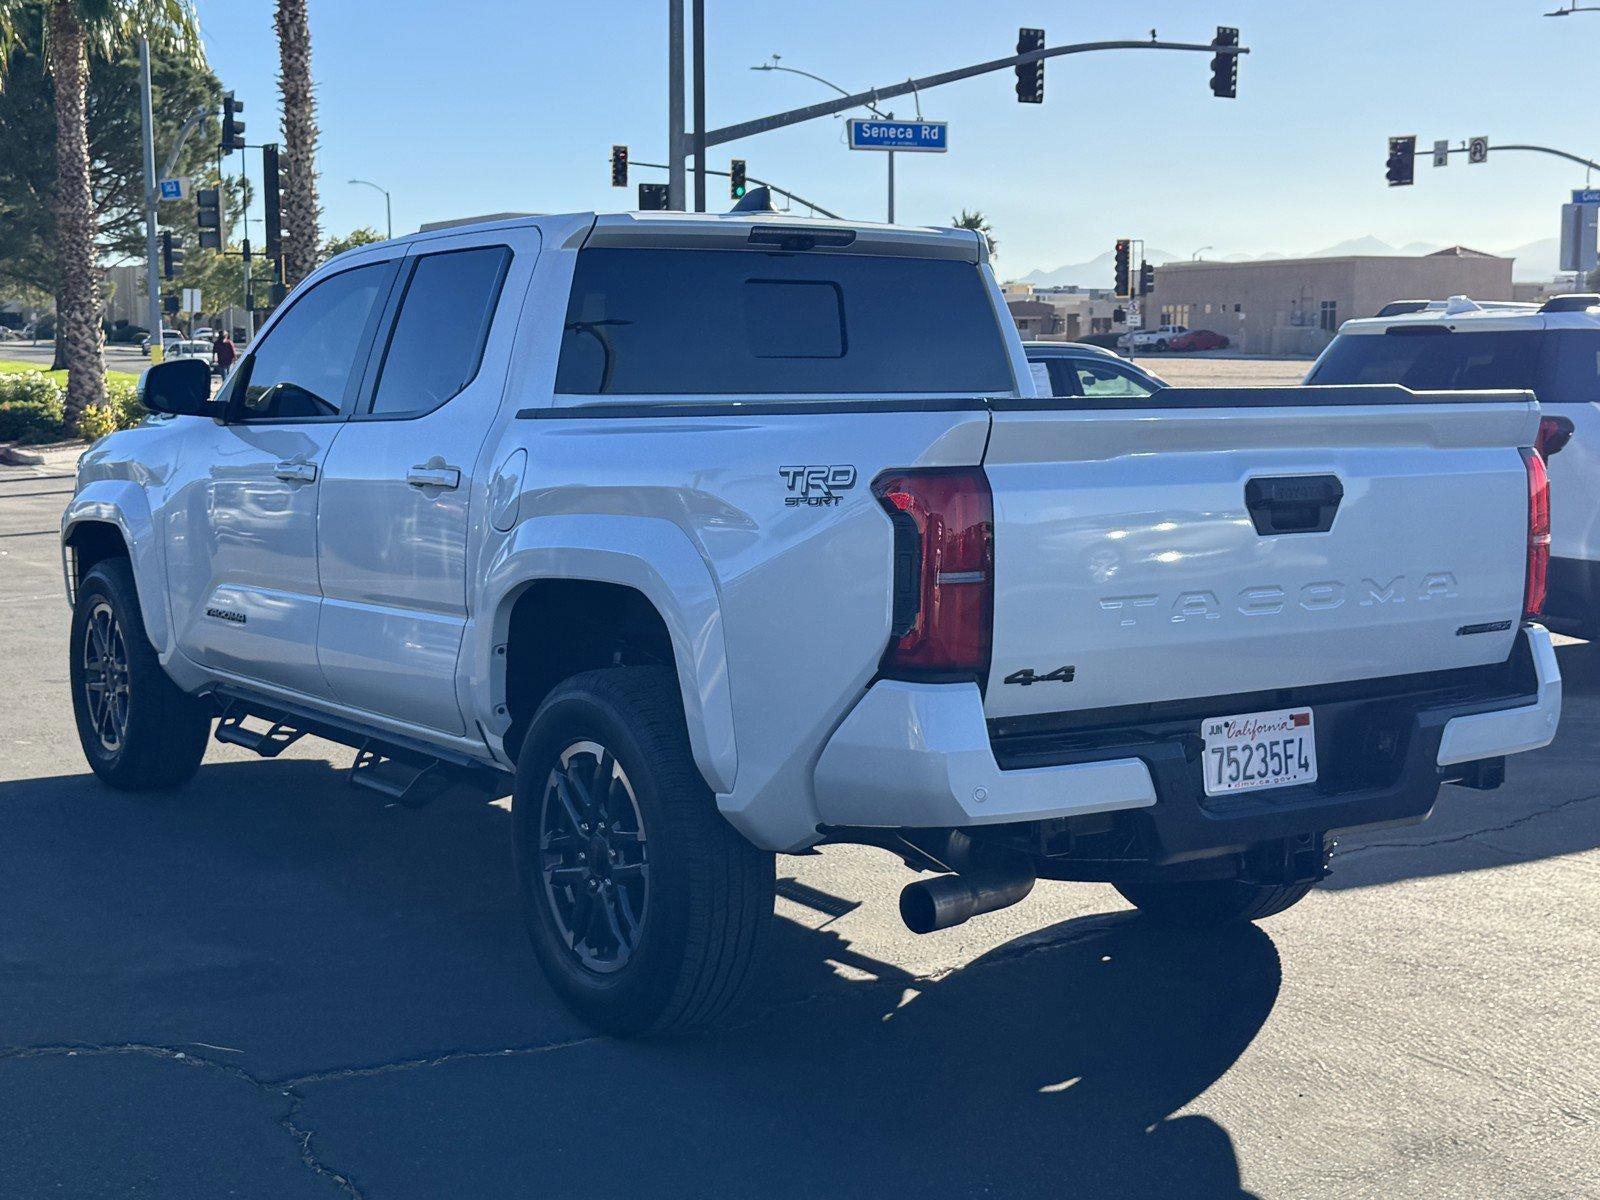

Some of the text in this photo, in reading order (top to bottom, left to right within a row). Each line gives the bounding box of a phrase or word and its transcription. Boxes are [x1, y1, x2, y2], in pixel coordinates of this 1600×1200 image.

[862, 123, 939, 140] Seneca Rd
[779, 464, 857, 497] TRD
[784, 495, 844, 508] SPORT
[1100, 571, 1458, 627] TACOMA
[1209, 717, 1295, 741] JUN California
[1211, 737, 1310, 784] 75235F4
[1234, 774, 1292, 789] dmv.ca.gov
